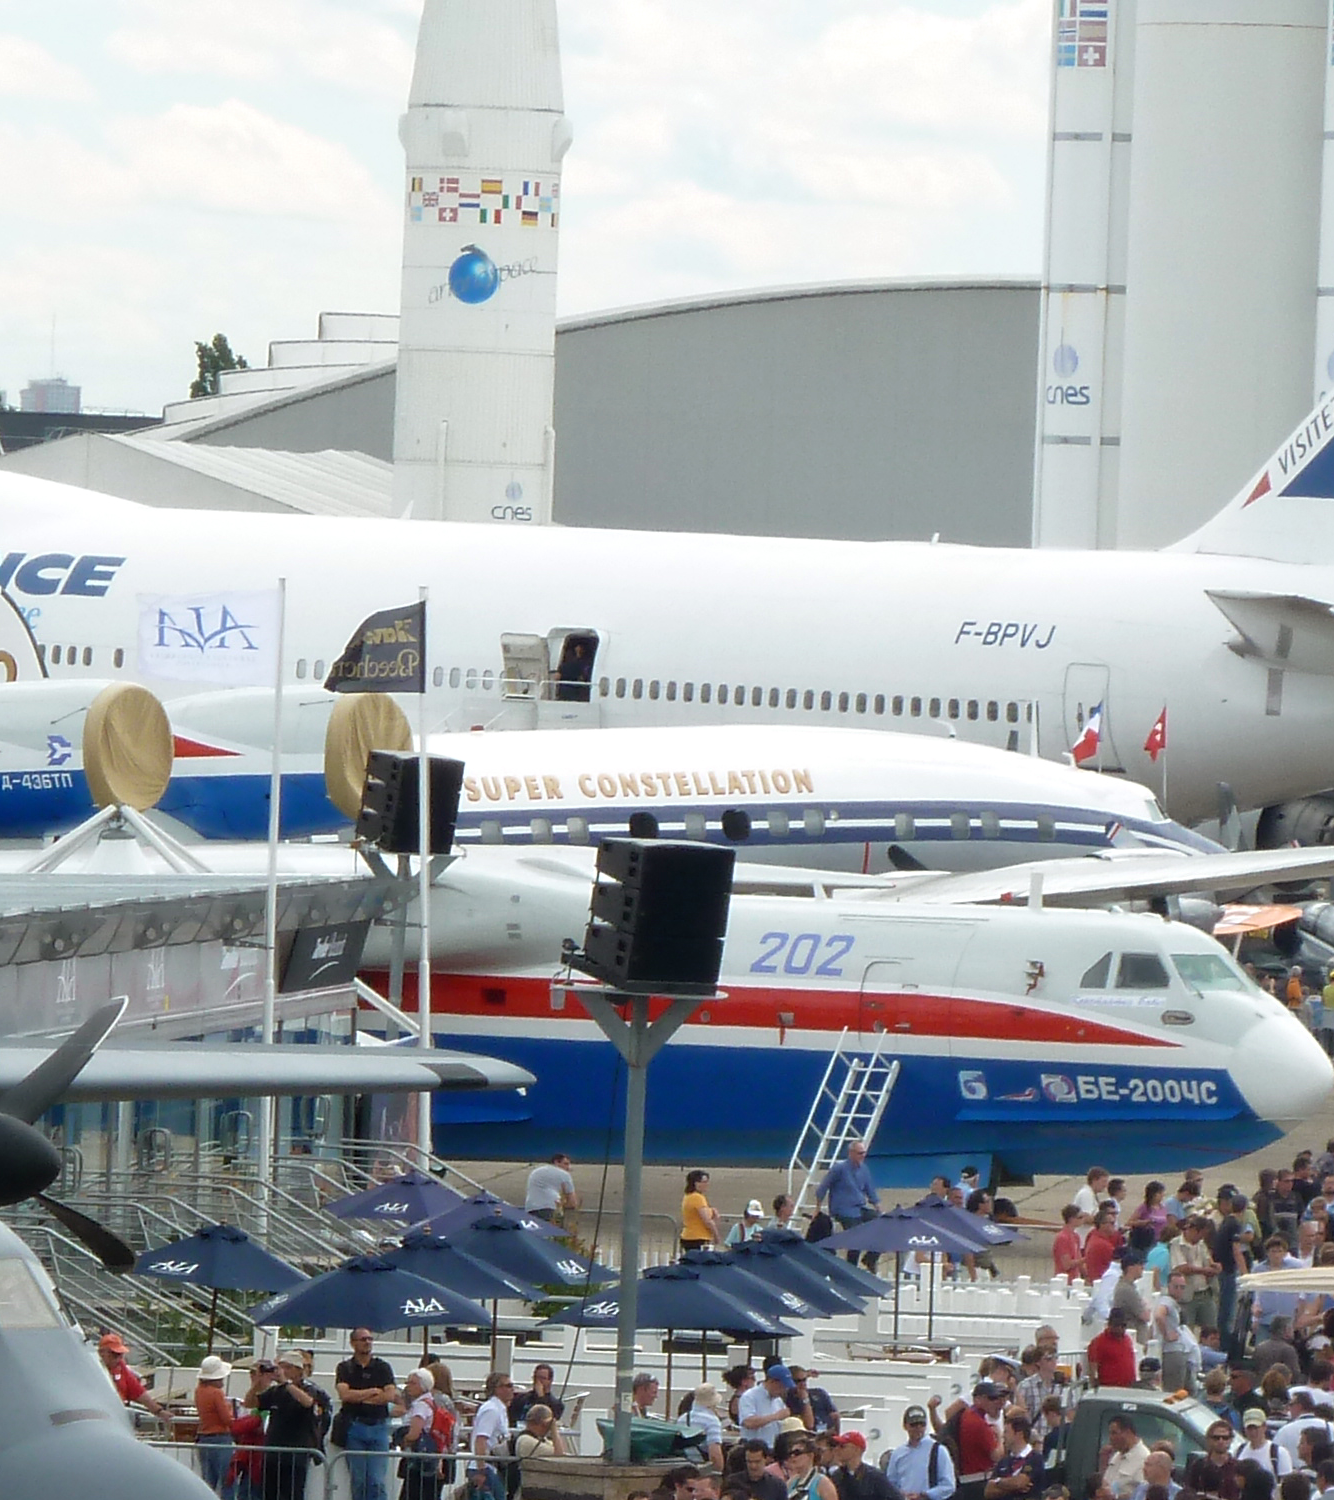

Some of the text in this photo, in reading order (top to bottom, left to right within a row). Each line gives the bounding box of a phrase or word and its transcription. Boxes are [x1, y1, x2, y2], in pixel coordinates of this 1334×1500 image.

[1046, 385, 1091, 406] cnes
[491, 505, 533, 521] cnes
[955, 620, 1057, 649] F-BPVJ
[464, 767, 815, 803] SUPER CONSTELLATION
[749, 931, 856, 977] 202
[1076, 1075, 1219, 1105] БЕ-200ЧС
